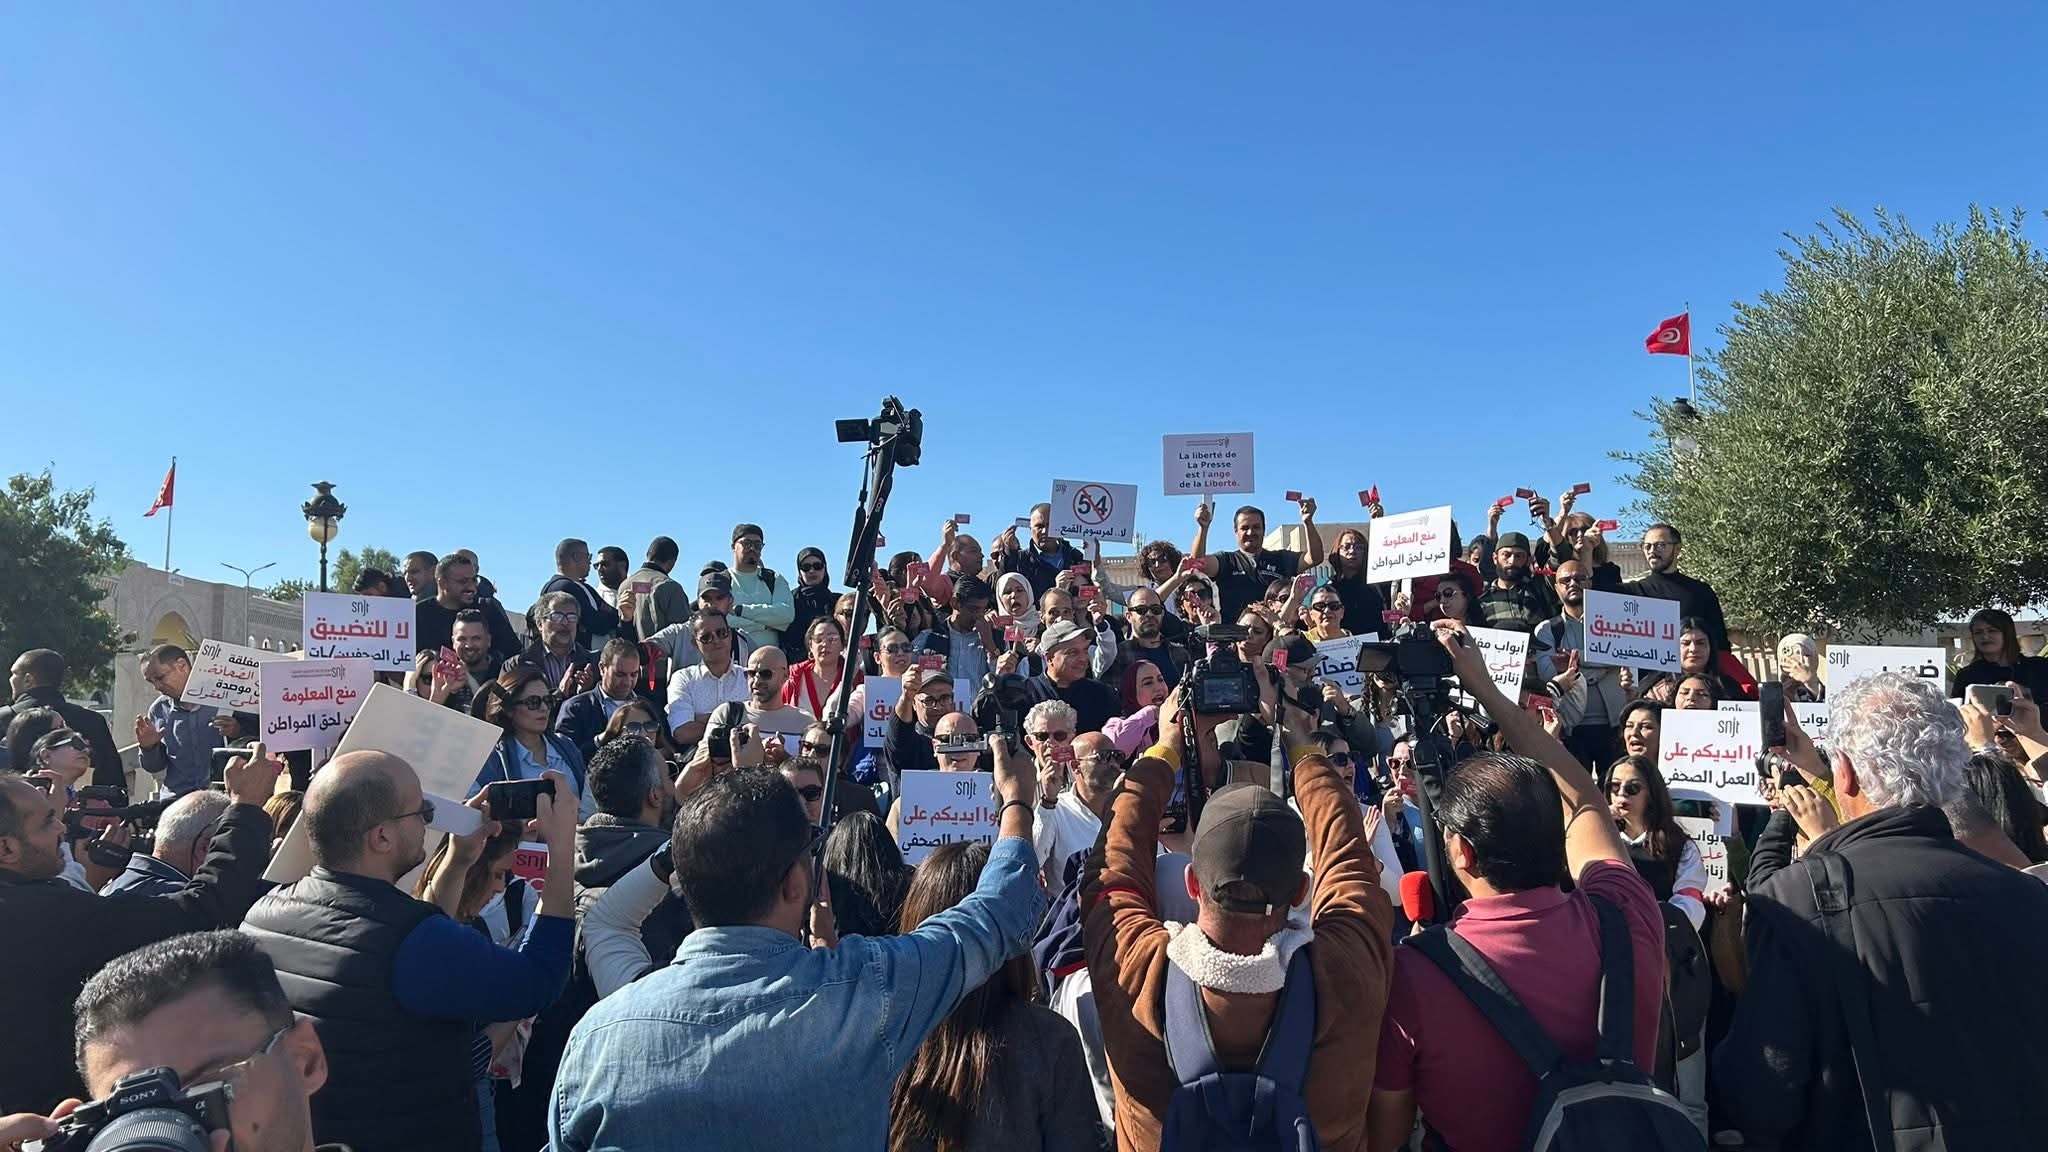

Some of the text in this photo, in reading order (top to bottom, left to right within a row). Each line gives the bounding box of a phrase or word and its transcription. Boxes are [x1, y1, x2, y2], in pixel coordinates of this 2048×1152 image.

[1083, 528, 1113, 538] لمرسوم
[1382, 531, 1436, 548] منع المعلومة
[1371, 548, 1446, 570] ضرب لحق المواطن
[351, 600, 369, 616] snjt
[310, 617, 409, 640] لا للتضييق
[1590, 614, 1675, 640] لا للتضييق
[1494, 640, 1525, 655] أبواب
[392, 650, 411, 665] على
[1489, 656, 1521, 671] على
[1660, 651, 1677, 665] على
[1829, 650, 1851, 668] snjt
[216, 679, 251, 694] موصدة
[282, 686, 333, 705] المعلومة
[336, 686, 356, 704] منع
[268, 713, 316, 735] المواطن
[319, 712, 340, 731] لحق
[1717, 716, 1741, 737] snjt
[1800, 713, 1828, 727] بواب
[1664, 742, 1688, 760] على
[1715, 770, 1755, 788] العمل
[956, 778, 977, 799] snjt
[903, 805, 927, 825] على
[902, 833, 951, 856] الصحفي
[120, 1088, 158, 1105] SONY
